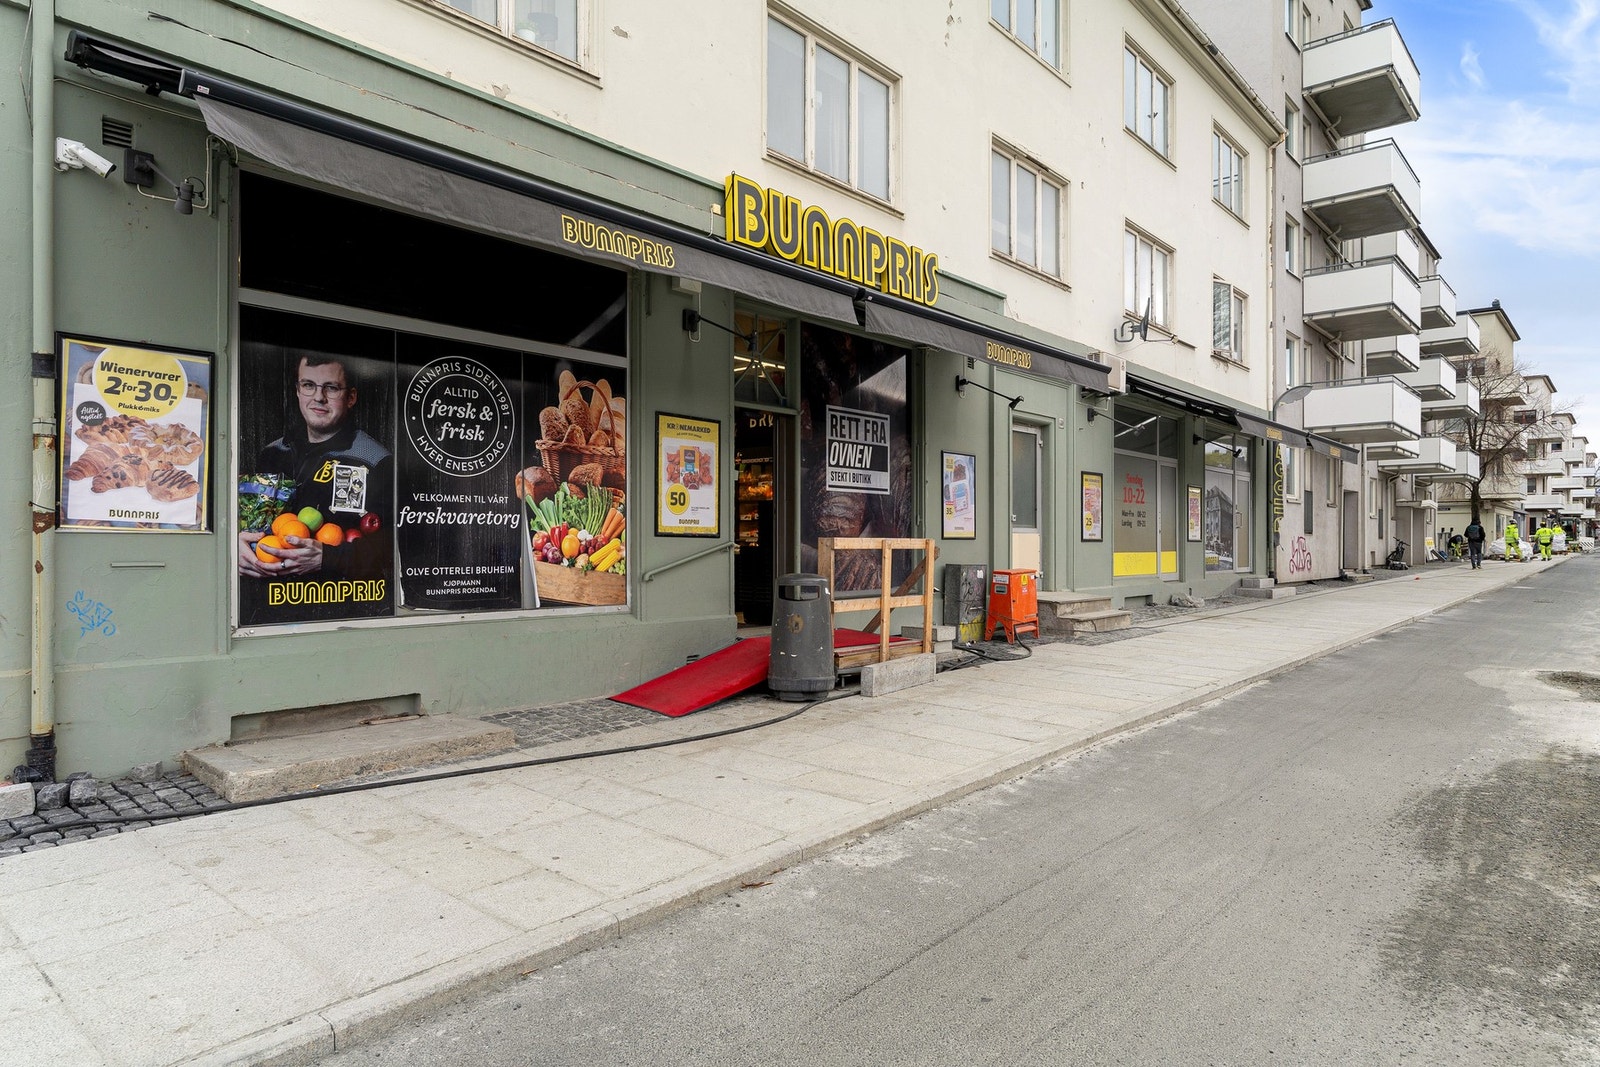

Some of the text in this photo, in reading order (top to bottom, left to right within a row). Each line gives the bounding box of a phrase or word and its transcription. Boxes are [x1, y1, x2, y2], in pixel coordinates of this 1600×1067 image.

[561, 214, 675, 269] BUNNPRIS
[725, 174, 940, 307] BUNNPRIS
[986, 341, 1032, 370] BUNNPRIS
[100, 361, 181, 382] Wienervarer
[410, 362, 510, 416] BUNNPRIS SIDEN 1981
[443, 386, 479, 399] ALLTID
[427, 398, 494, 421] fersk &
[437, 421, 485, 441] frisk
[830, 413, 887, 444] RETT FRA
[416, 435, 505, 472] HVER ENESTE DAG
[829, 441, 872, 469] OVNEN
[830, 470, 848, 482] STEKT
[851, 472, 872, 485] BUTIKK
[413, 493, 509, 504] VELKOMMEN TIL VÅRT
[670, 491, 686, 506] 50
[1123, 486, 1145, 504] 10-22
[109, 508, 160, 520] BUNNPRIS
[397, 505, 520, 529] ferskvaretorg
[406, 565, 515, 576] OLVE OTTERLEI BRUHEIM
[268, 579, 385, 605] BUNNPRIS
[426, 586, 497, 596] BUNNPRIS ROSENDAL
[443, 579, 481, 587] KJØPMANN
